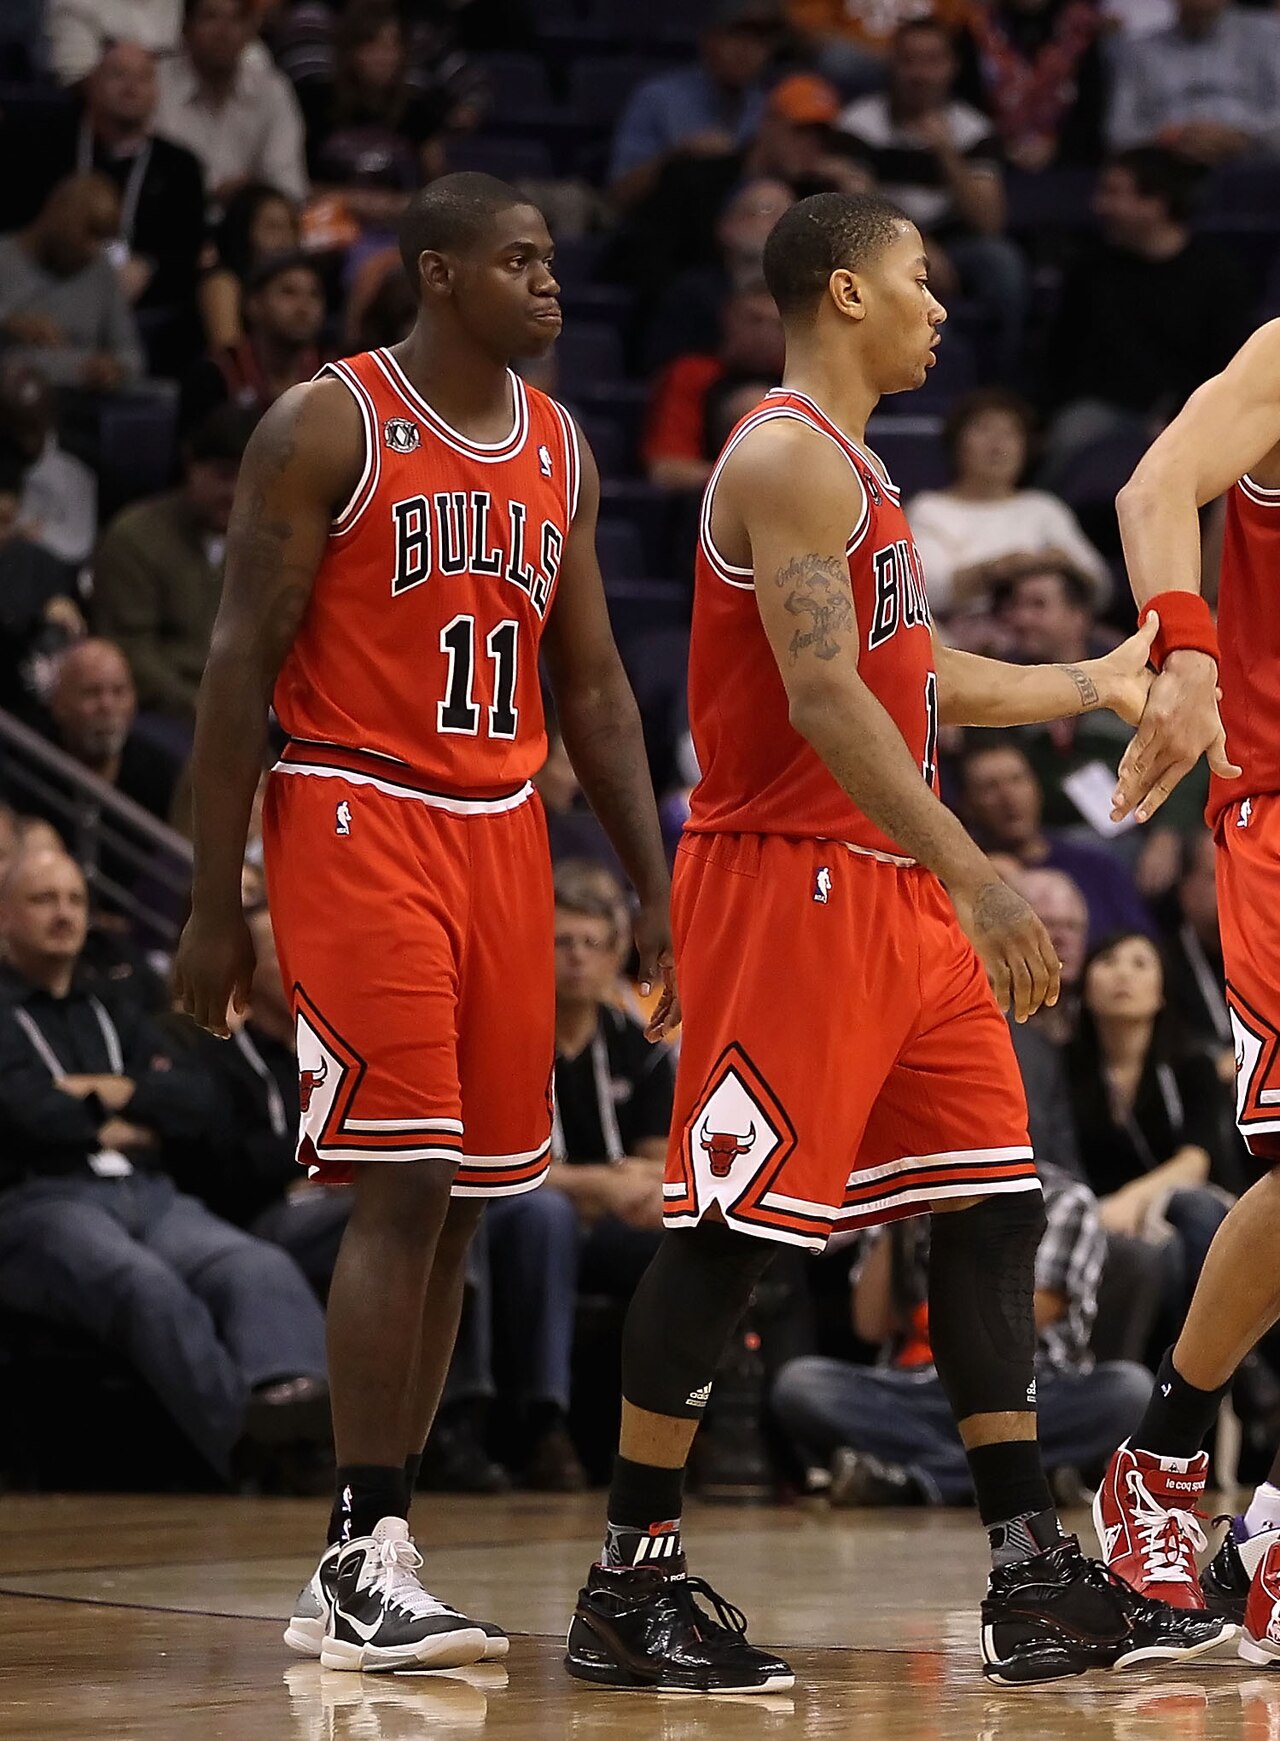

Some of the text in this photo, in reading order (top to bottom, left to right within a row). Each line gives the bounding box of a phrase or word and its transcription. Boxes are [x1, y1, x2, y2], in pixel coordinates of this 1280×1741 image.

[391, 490, 564, 622] BULLS
[436, 614, 520, 740] 11
[922, 671, 937, 788] 1
[1175, 1481, 1192, 1492] coq
